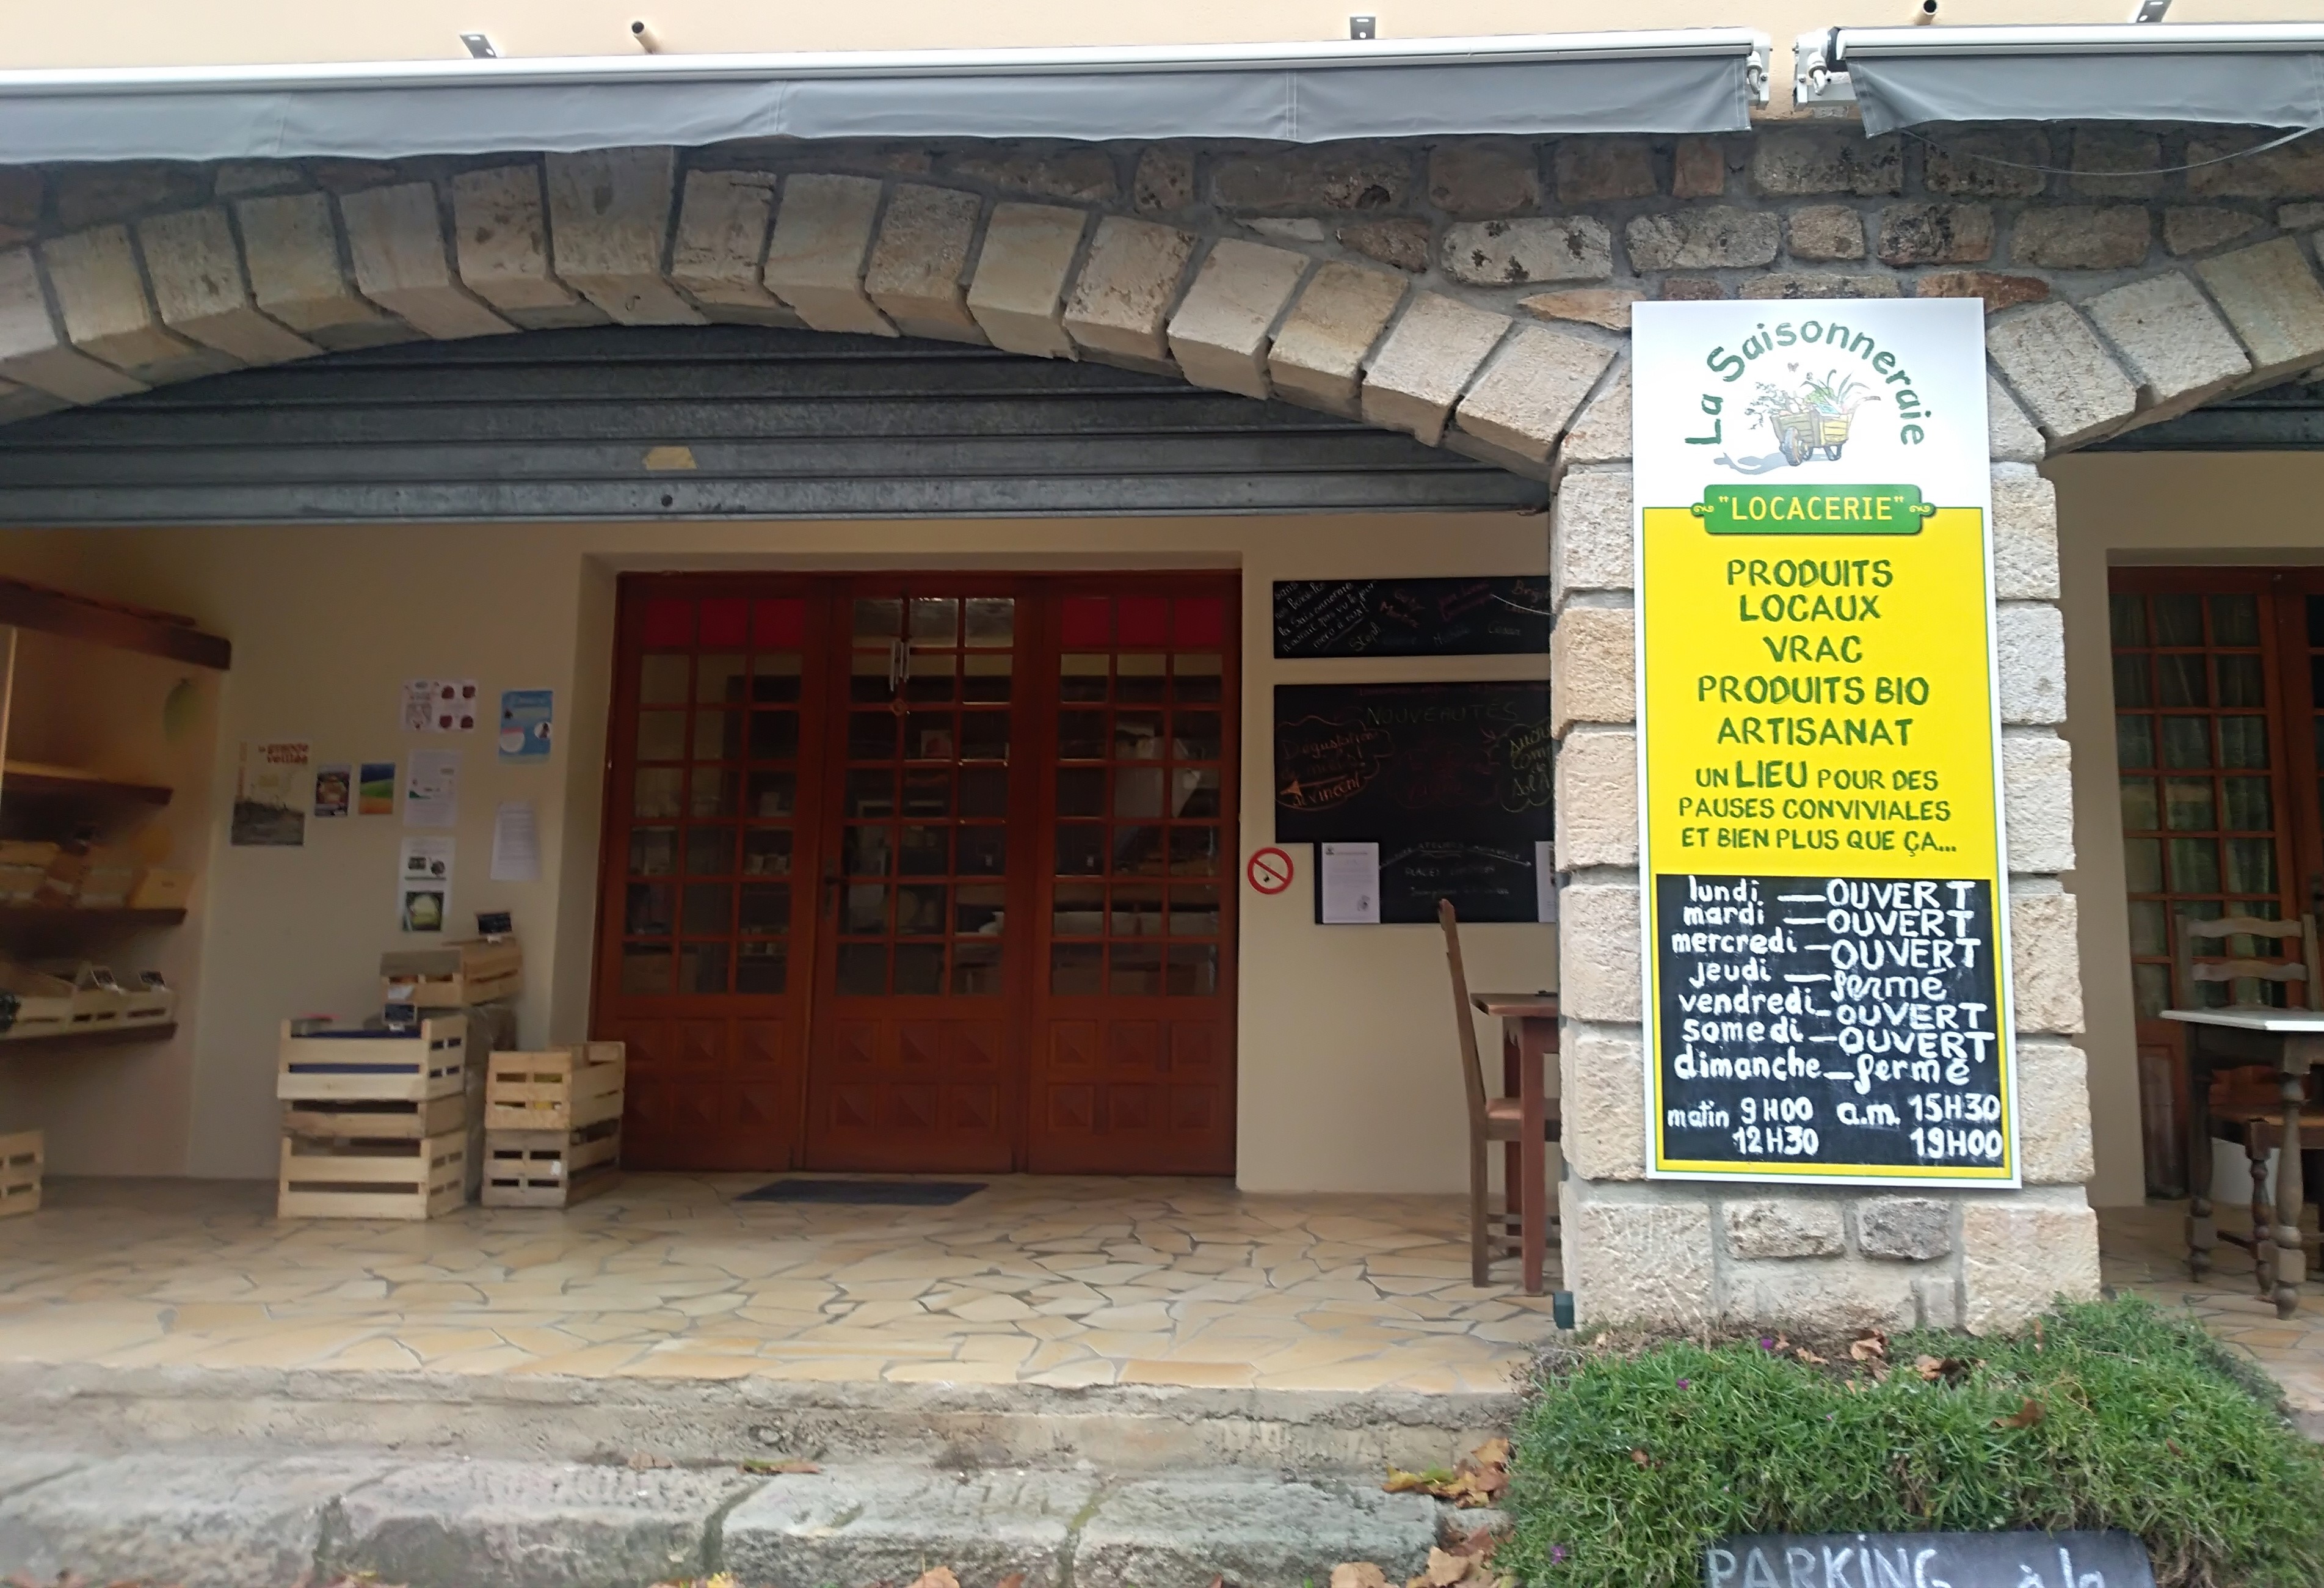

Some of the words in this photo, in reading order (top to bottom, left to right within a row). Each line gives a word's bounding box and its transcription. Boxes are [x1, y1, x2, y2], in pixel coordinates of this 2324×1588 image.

[1685, 394, 1723, 445] La
[1707, 320, 1931, 445] Saisonneraie
[1719, 496, 1904, 520] "LOCACERIE"
[1728, 559, 1893, 588] PRODUITS
[1740, 594, 1880, 622] LOCAUX
[1763, 635, 1862, 663] VRAC
[1699, 676, 1865, 705] PRODUITS
[1876, 677, 1929, 705] BIO
[1718, 717, 1912, 746] ARTISANAT
[1696, 768, 1728, 787] UN
[1736, 760, 1807, 788] LIEU
[1818, 770, 1884, 789] POUR
[1893, 770, 1938, 791] DES
[1680, 797, 1774, 818] PAUSES
[1783, 799, 1950, 821] CONVIVIALES
[1682, 828, 1709, 847] ET
[1718, 828, 1769, 848] BIEN
[1777, 829, 1839, 850] PLUS
[1847, 830, 1894, 850] QUE
[1904, 831, 1956, 855] ÇA...
[1689, 875, 1759, 901] lundi
[1826, 878, 1976, 909] OUVERT
[1683, 901, 1765, 926] mardi
[1826, 909, 1975, 938] OUVERT
[1671, 927, 1797, 954] mercredi
[1831, 938, 1981, 971] OUVERT
[1688, 956, 1771, 989] jeudi
[1831, 968, 1947, 1002] fermé
[1679, 985, 1816, 1016] vendredi
[1837, 1002, 1988, 1030] OUVERT
[1682, 1016, 1804, 1043] samedi
[1839, 1027, 1995, 1063] OUVERT
[1674, 1043, 1822, 1080] dimanche
[1854, 1054, 1970, 1094] fermé
[1668, 1100, 1729, 1129] matin
[1836, 1102, 1901, 1125] a.m.
[1907, 1093, 2000, 1122] 15H30
[1732, 1124, 1819, 1156] 12H30
[1909, 1127, 2003, 1159] 19H00
